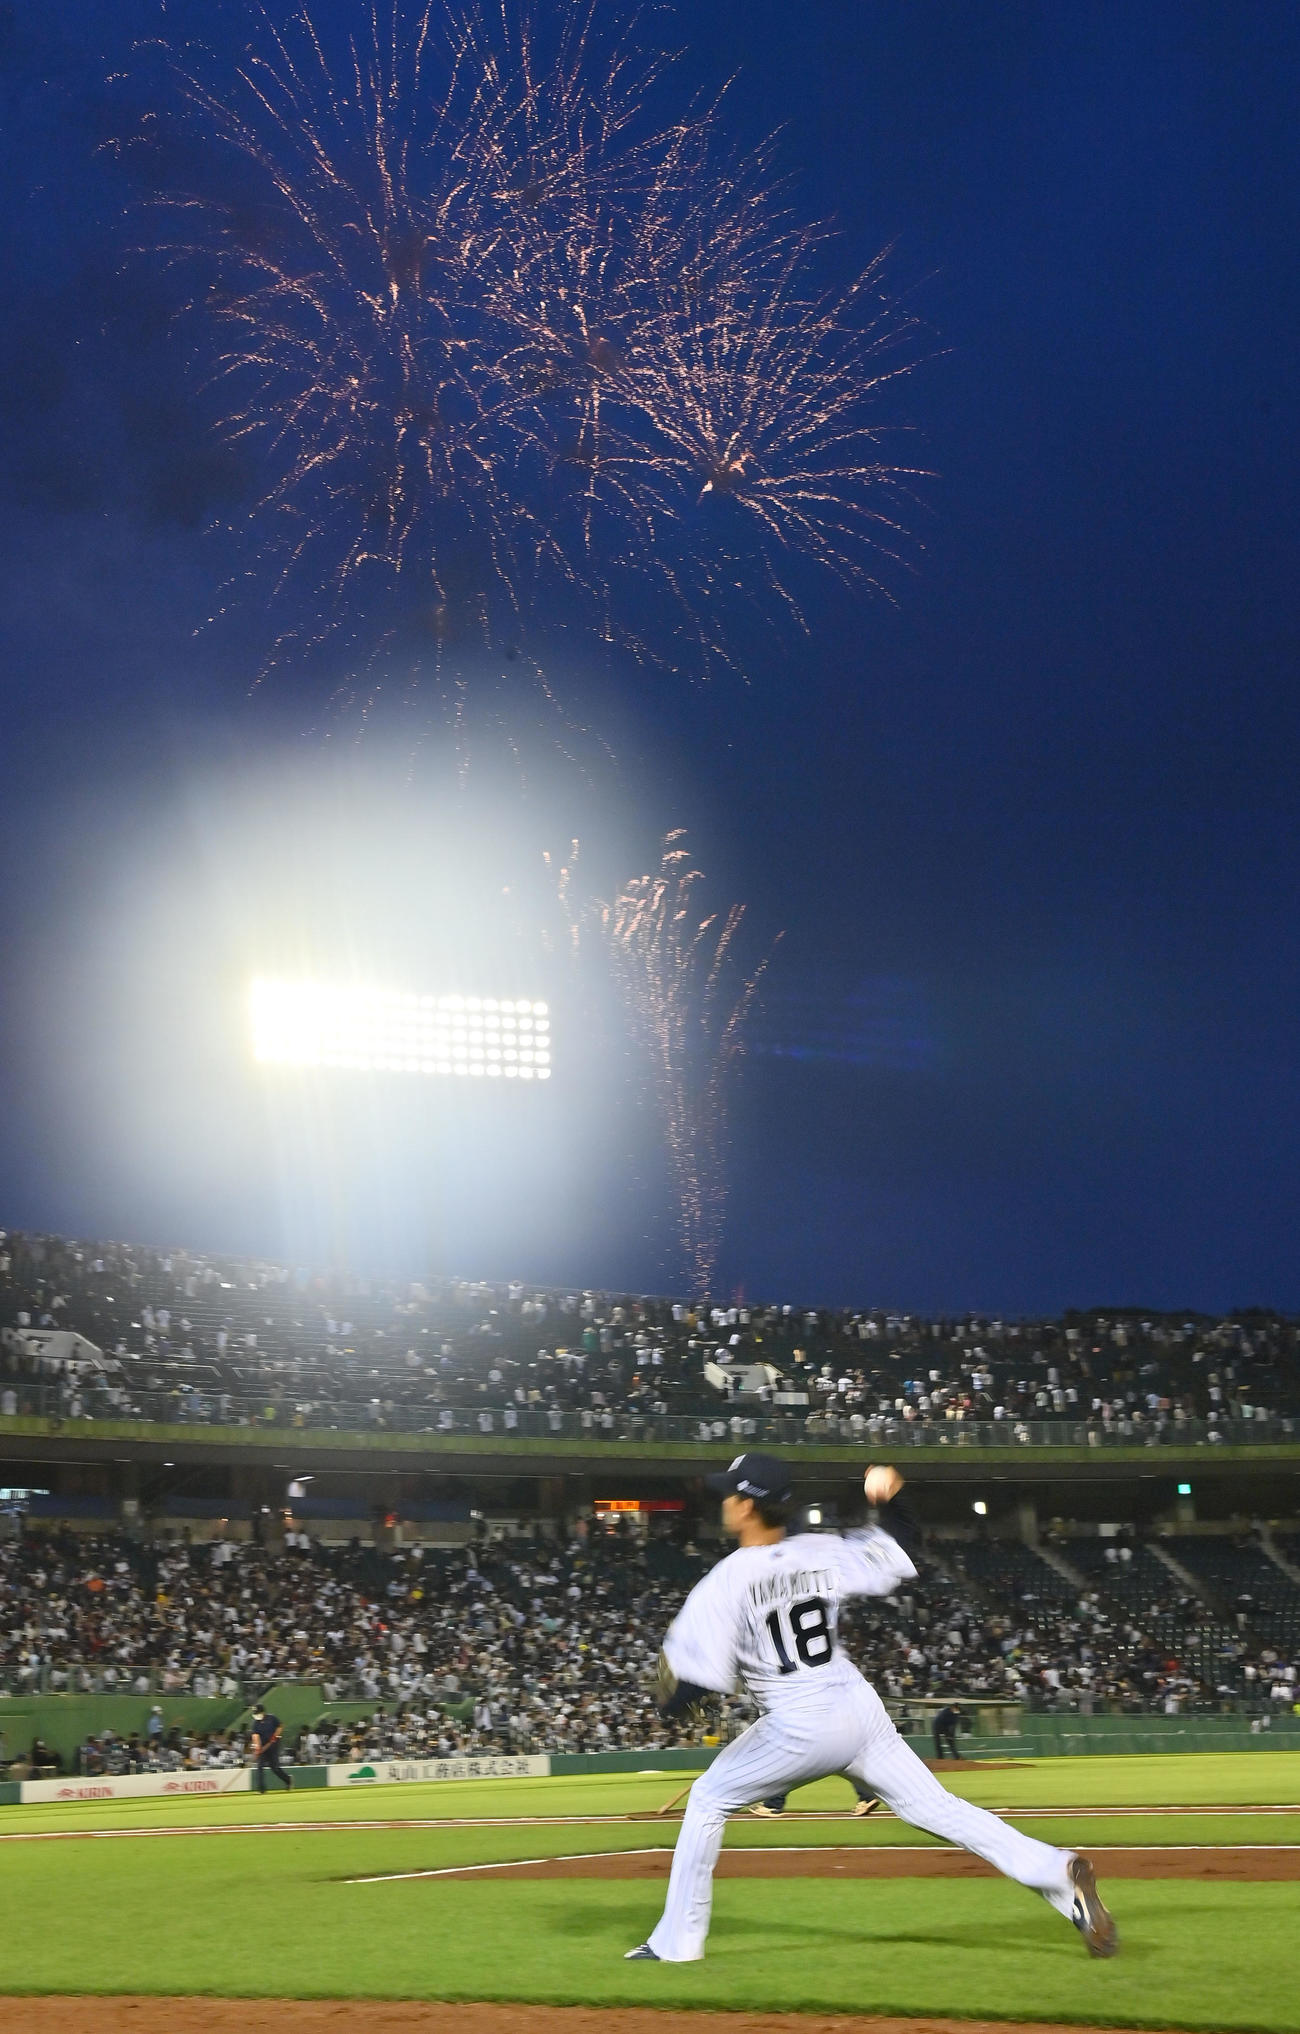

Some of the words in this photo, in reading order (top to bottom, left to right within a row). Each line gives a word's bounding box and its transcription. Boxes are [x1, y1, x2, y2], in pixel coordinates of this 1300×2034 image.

[747, 1569, 837, 1606] YAMAMOTO
[766, 1596, 832, 1674] 18
[77, 1786, 114, 1798] KIRIN
[182, 1780, 219, 1791] KIRIN
